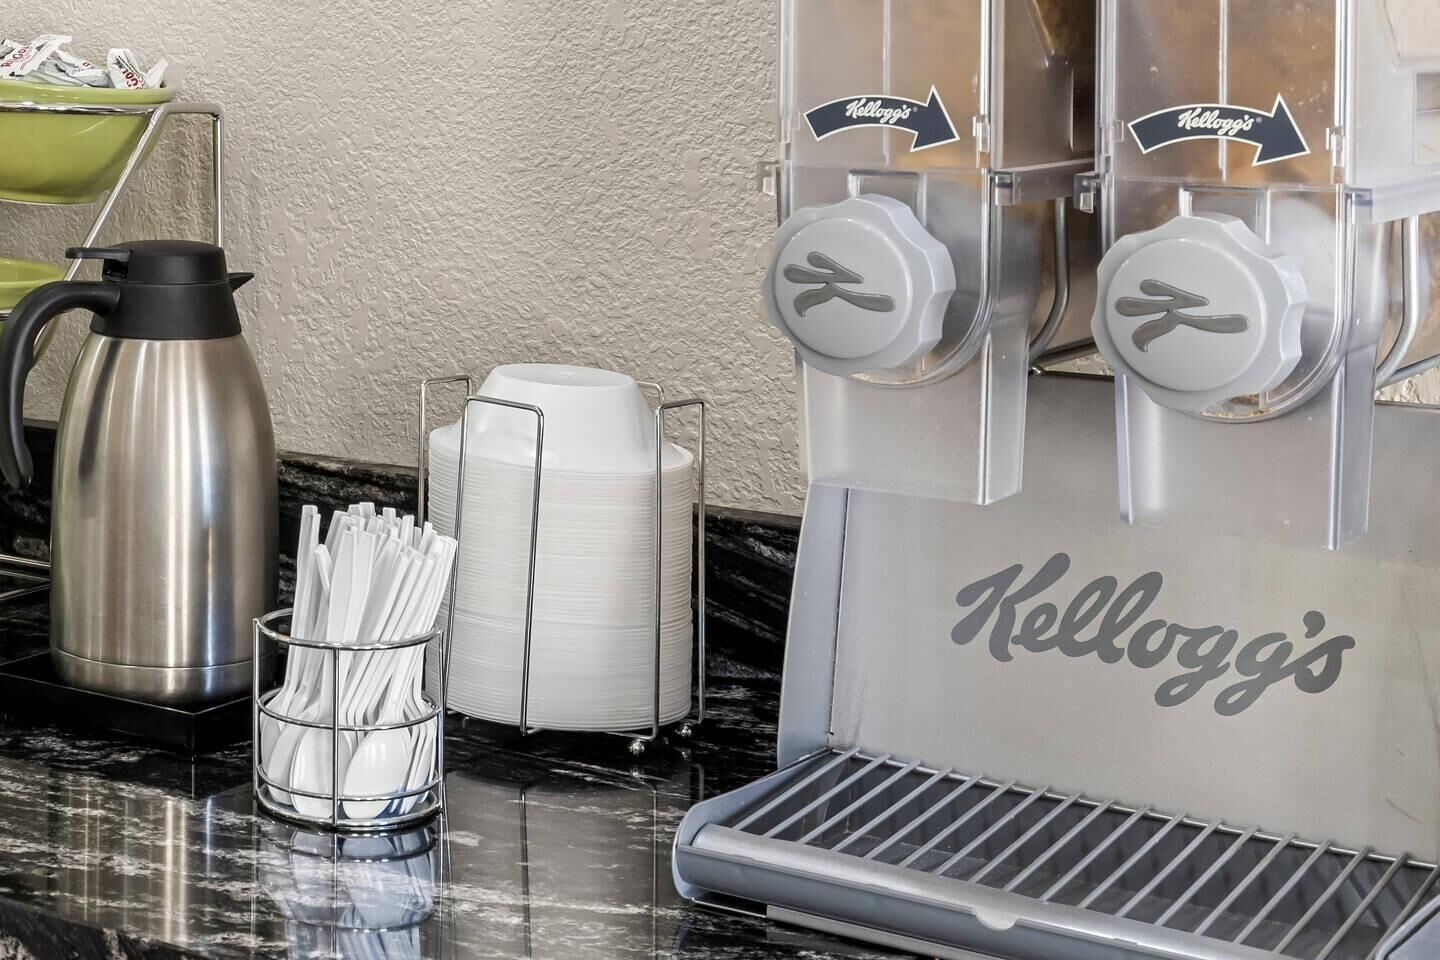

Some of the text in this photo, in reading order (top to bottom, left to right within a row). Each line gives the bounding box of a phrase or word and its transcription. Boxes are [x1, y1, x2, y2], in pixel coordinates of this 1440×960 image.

[845, 97, 912, 125] Kellogg's
[1177, 107, 1255, 136] Kellogg's
[951, 552, 1356, 717] Kellogg's
